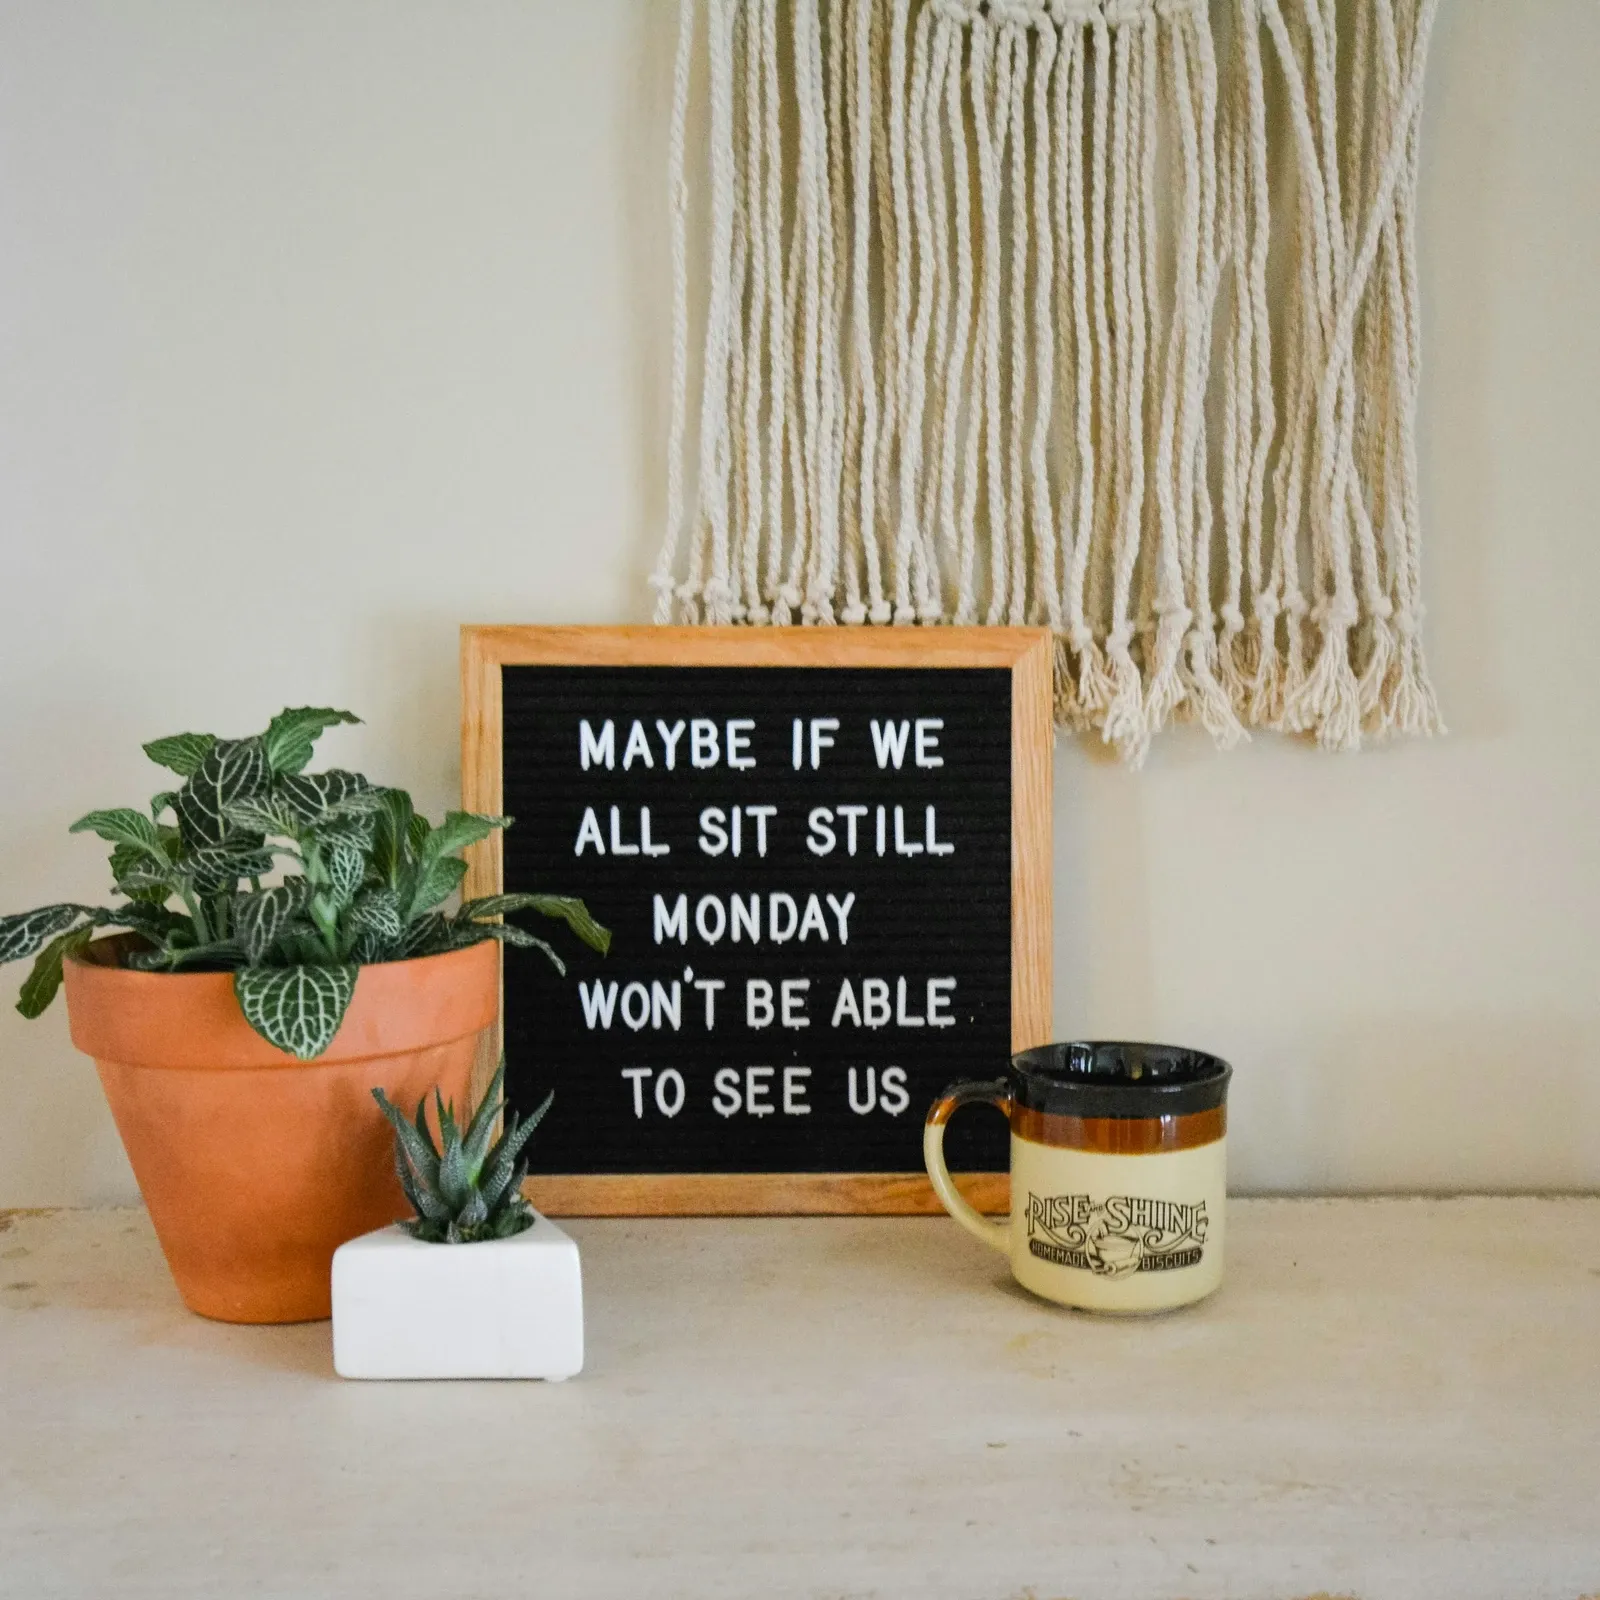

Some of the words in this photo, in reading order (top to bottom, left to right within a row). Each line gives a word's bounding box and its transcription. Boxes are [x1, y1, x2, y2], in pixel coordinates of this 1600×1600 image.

[579, 718, 757, 772] MAYBE
[792, 718, 841, 771] IF
[869, 718, 945, 770] WE
[574, 805, 671, 858] ALL
[698, 805, 778, 858] SIT
[806, 804, 955, 858] STILL
[653, 891, 856, 946] MONDAY
[578, 965, 726, 1032] WON'T
[746, 978, 811, 1031] BE
[831, 976, 957, 1031] ABLE
[621, 1067, 686, 1119] TO
[712, 1066, 812, 1118] SEE
[848, 1066, 910, 1117] US
[1025, 1192, 1090, 1243] RISE
[1105, 1196, 1208, 1245] SHINE
[1031, 1242, 1087, 1267] HOMEMADE
[1142, 1249, 1200, 1270] BISCUITS
